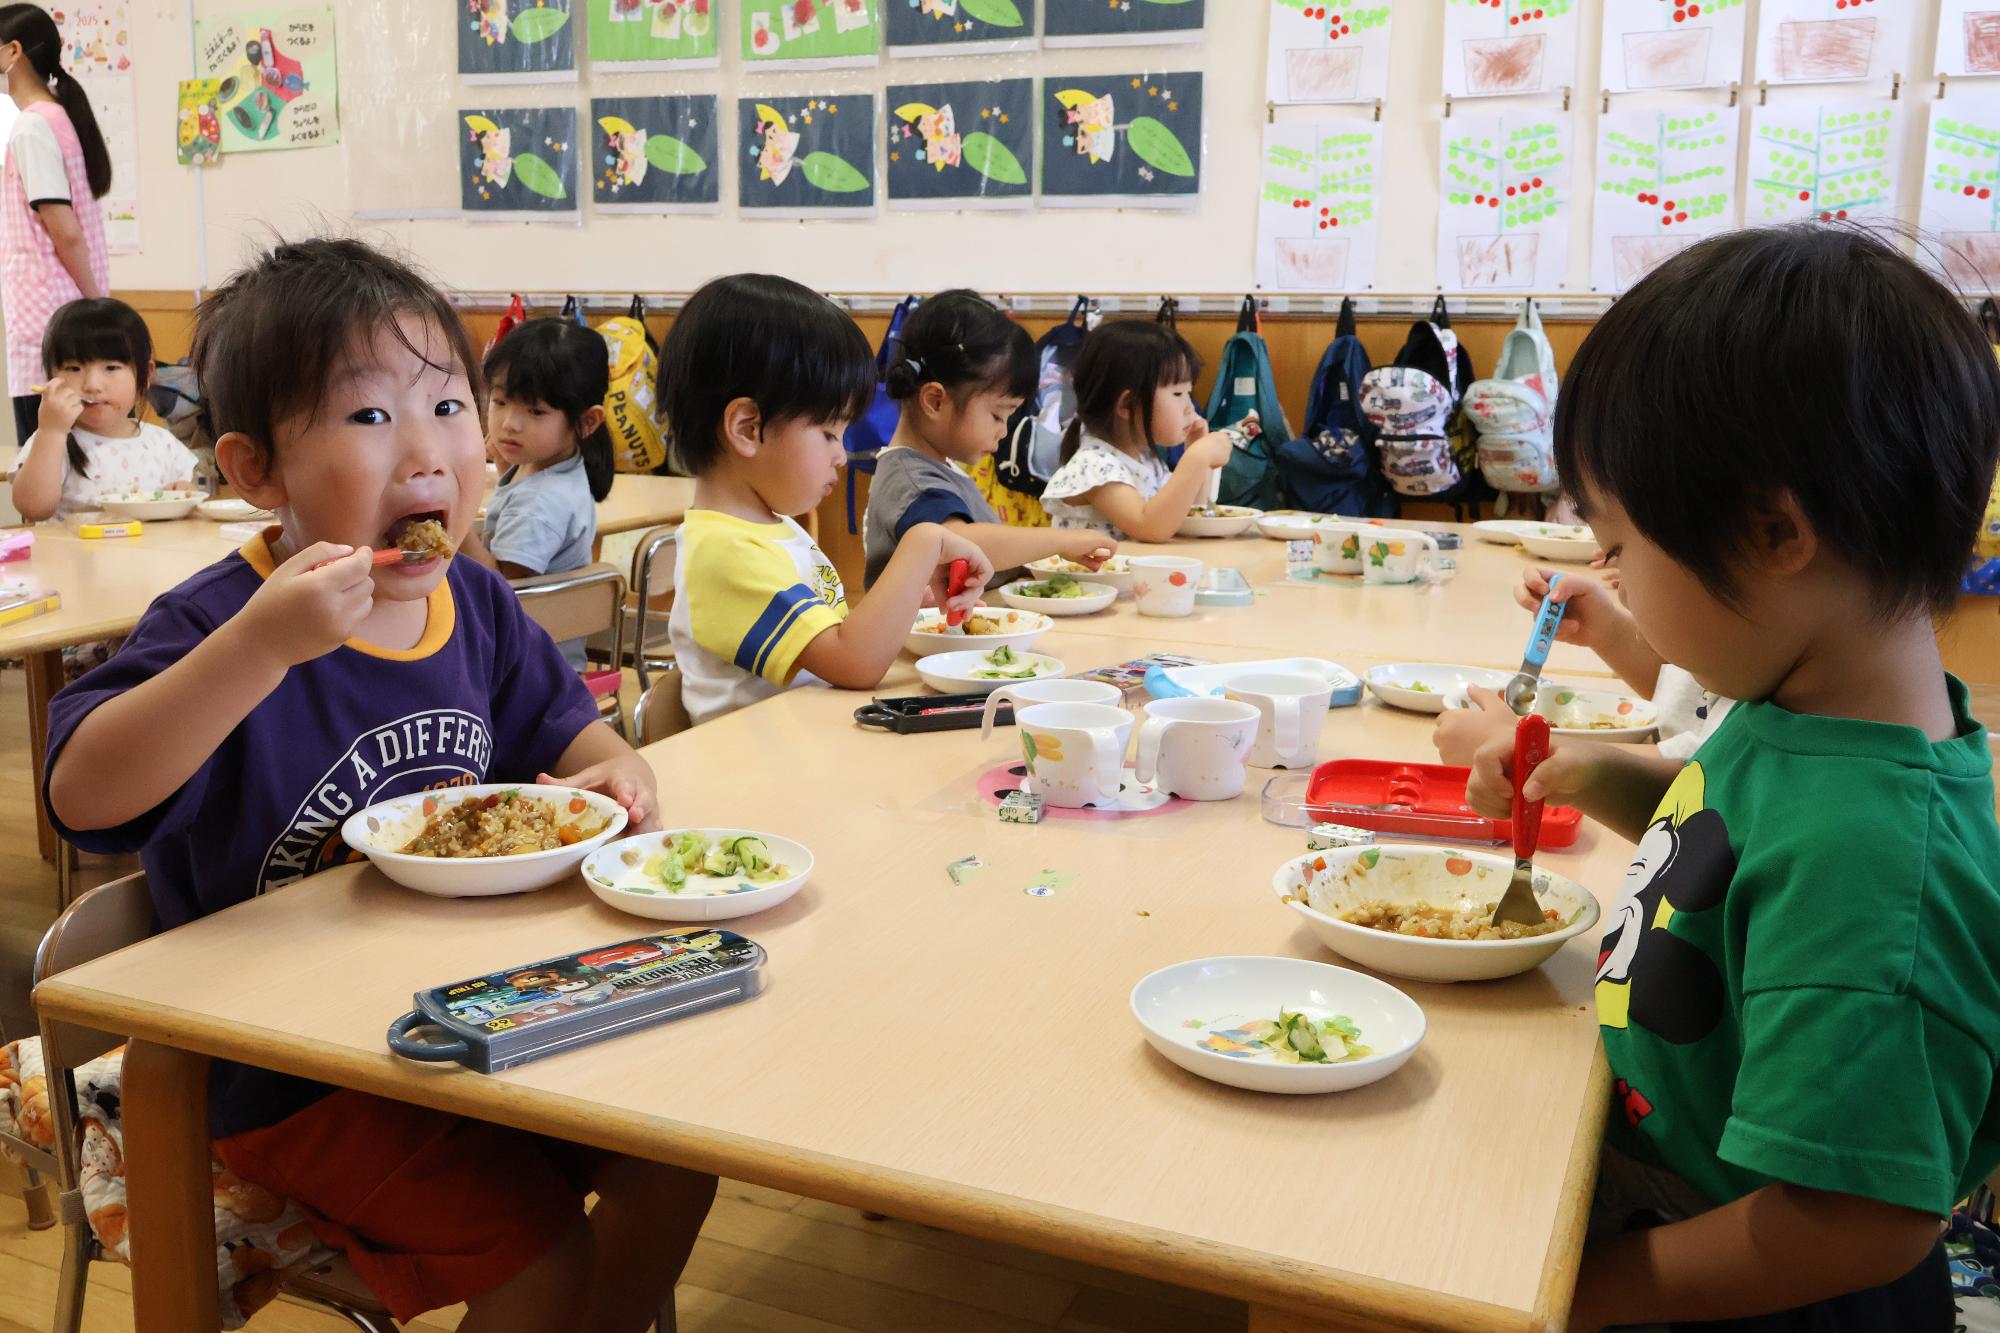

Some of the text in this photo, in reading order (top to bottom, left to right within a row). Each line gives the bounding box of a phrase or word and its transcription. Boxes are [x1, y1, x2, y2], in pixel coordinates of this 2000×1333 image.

[76, 15, 98, 26] 2025
[609, 389, 651, 468] PEANUTS
[350, 750, 378, 791] A
[611, 955, 714, 991] DESTINATION
[672, 964, 724, 983] DRIVE
